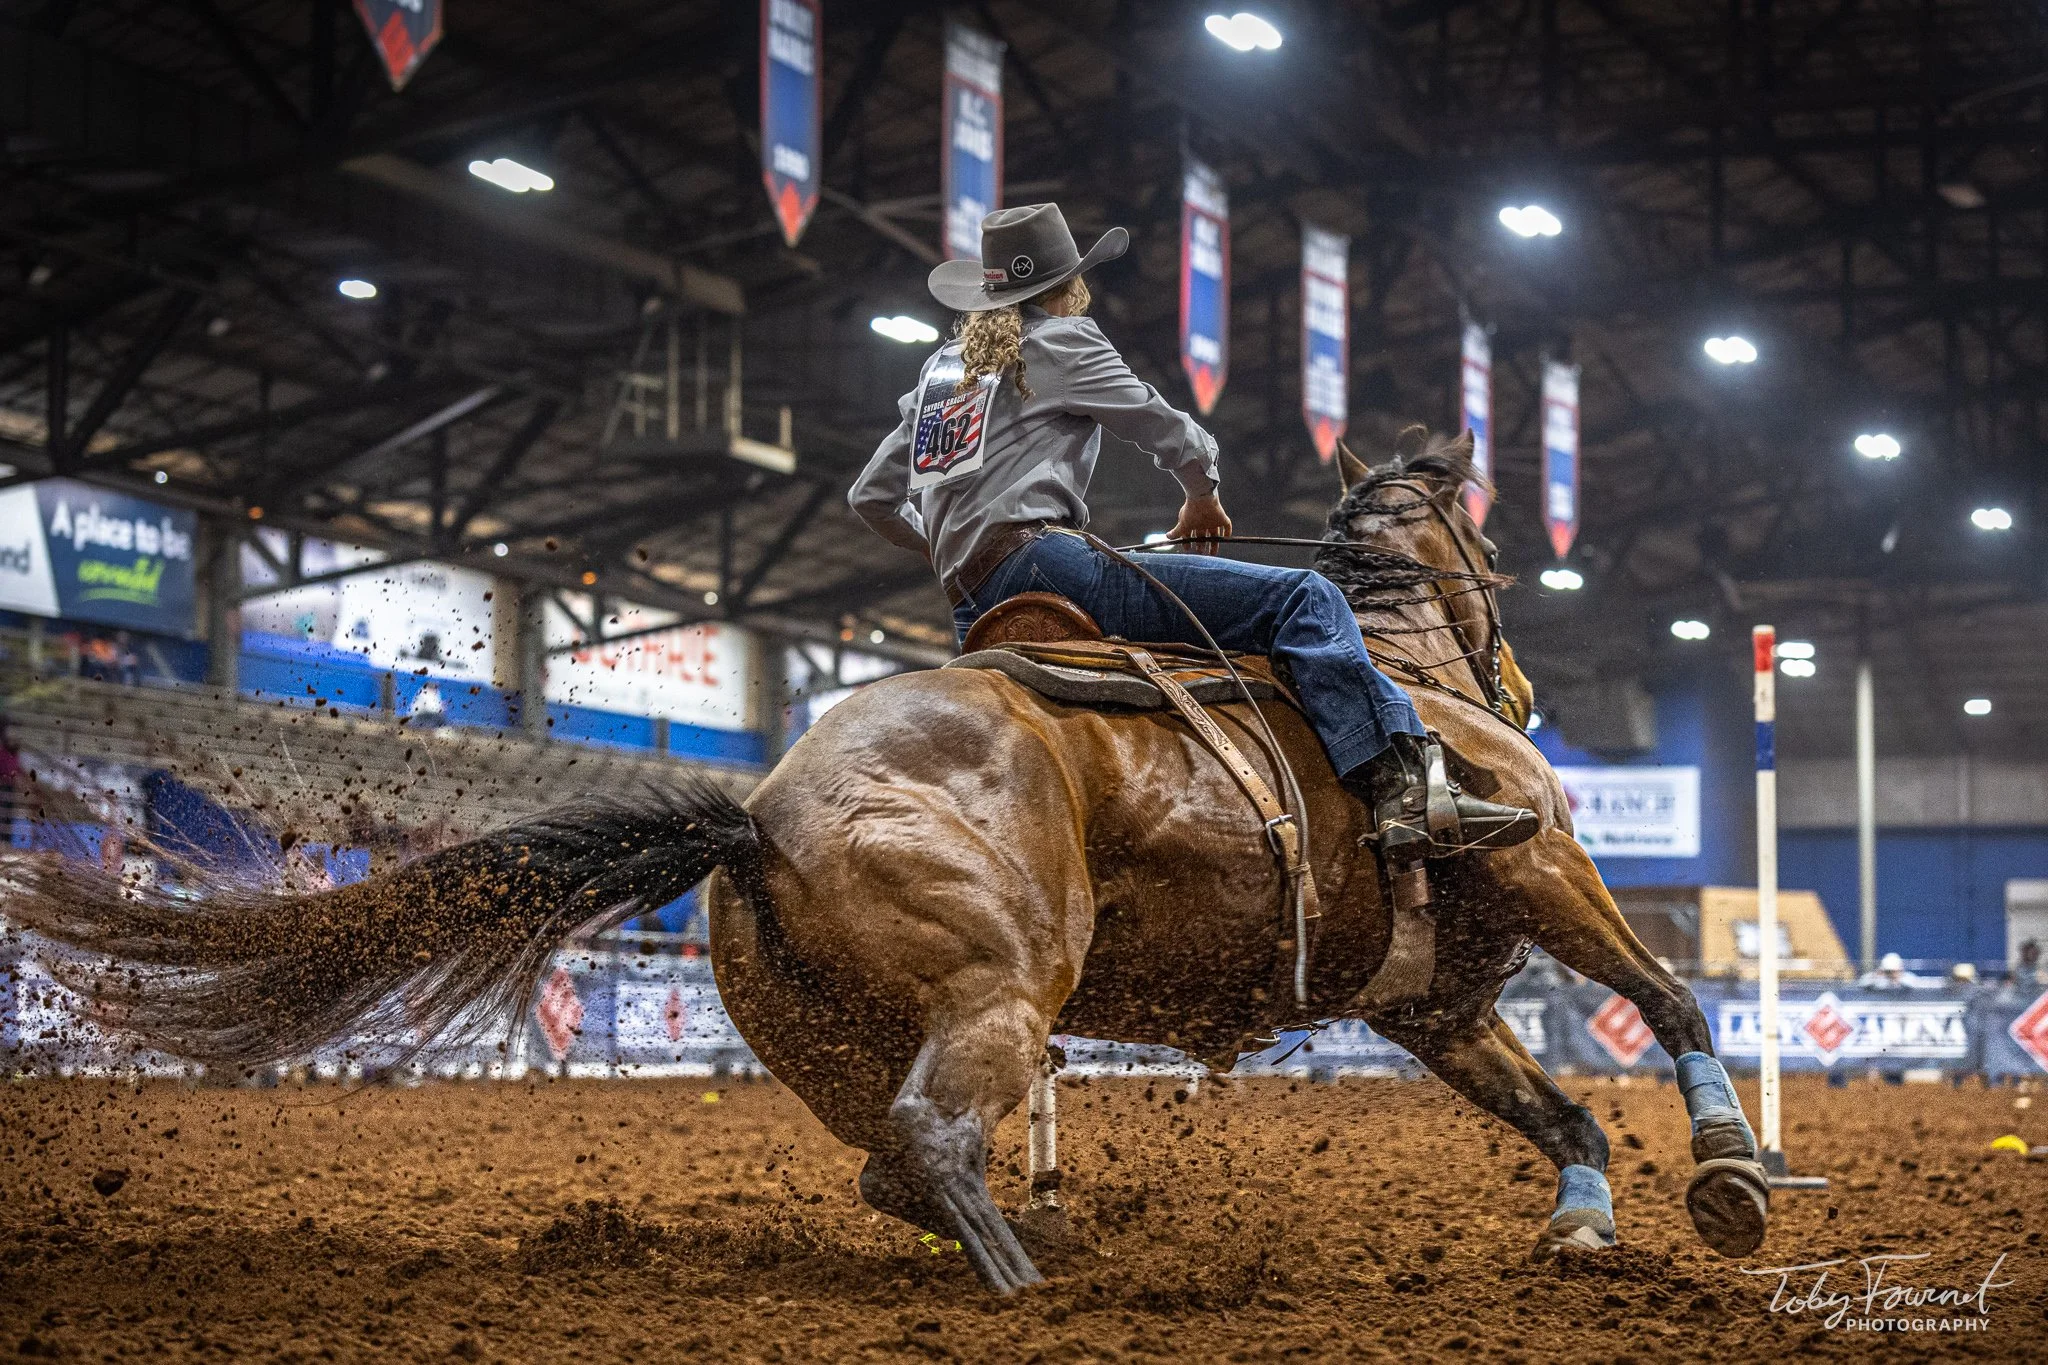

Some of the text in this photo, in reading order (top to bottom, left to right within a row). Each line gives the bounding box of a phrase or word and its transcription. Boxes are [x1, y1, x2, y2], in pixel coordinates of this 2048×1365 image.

[924, 412, 971, 460] 462
[51, 499, 74, 539] A
[74, 501, 134, 552] place
